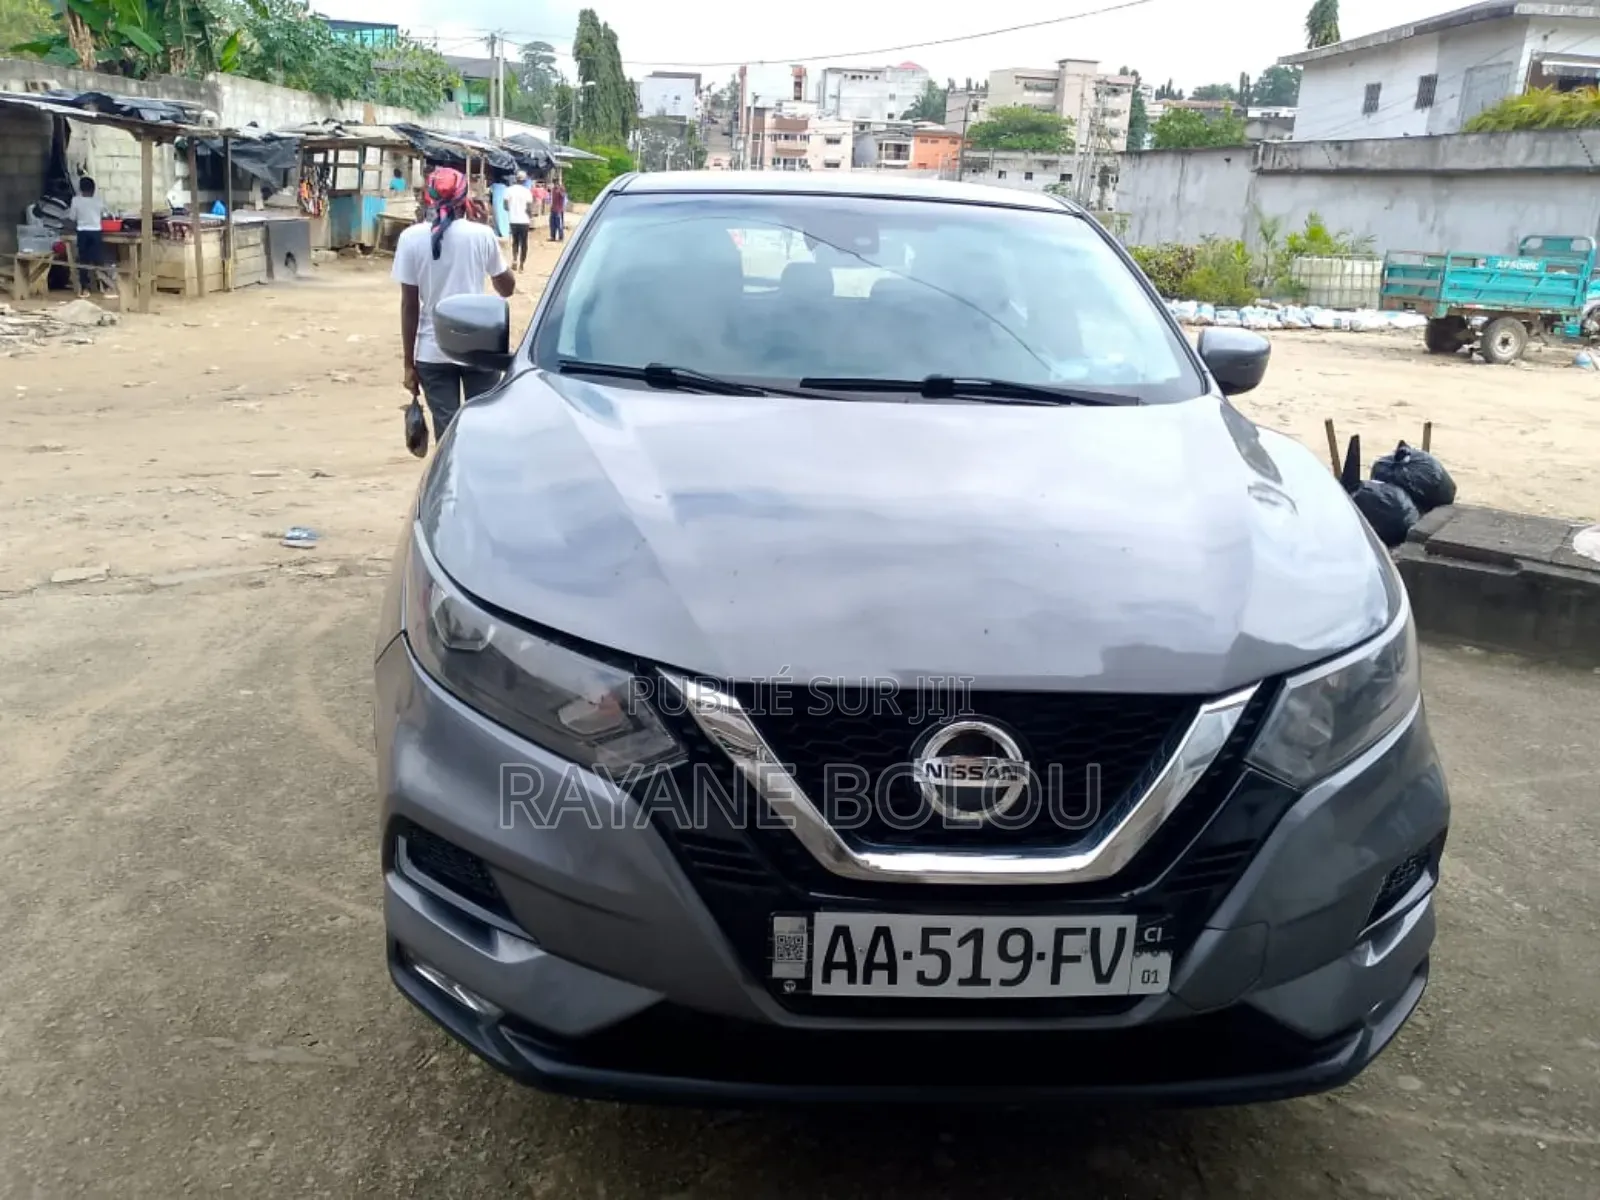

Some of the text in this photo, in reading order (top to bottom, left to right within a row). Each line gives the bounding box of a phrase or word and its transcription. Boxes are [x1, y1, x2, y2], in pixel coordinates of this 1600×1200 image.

[925, 762, 1020, 781] NISSAN
[1144, 927, 1162, 943] CI
[1141, 969, 1160, 985] 01
